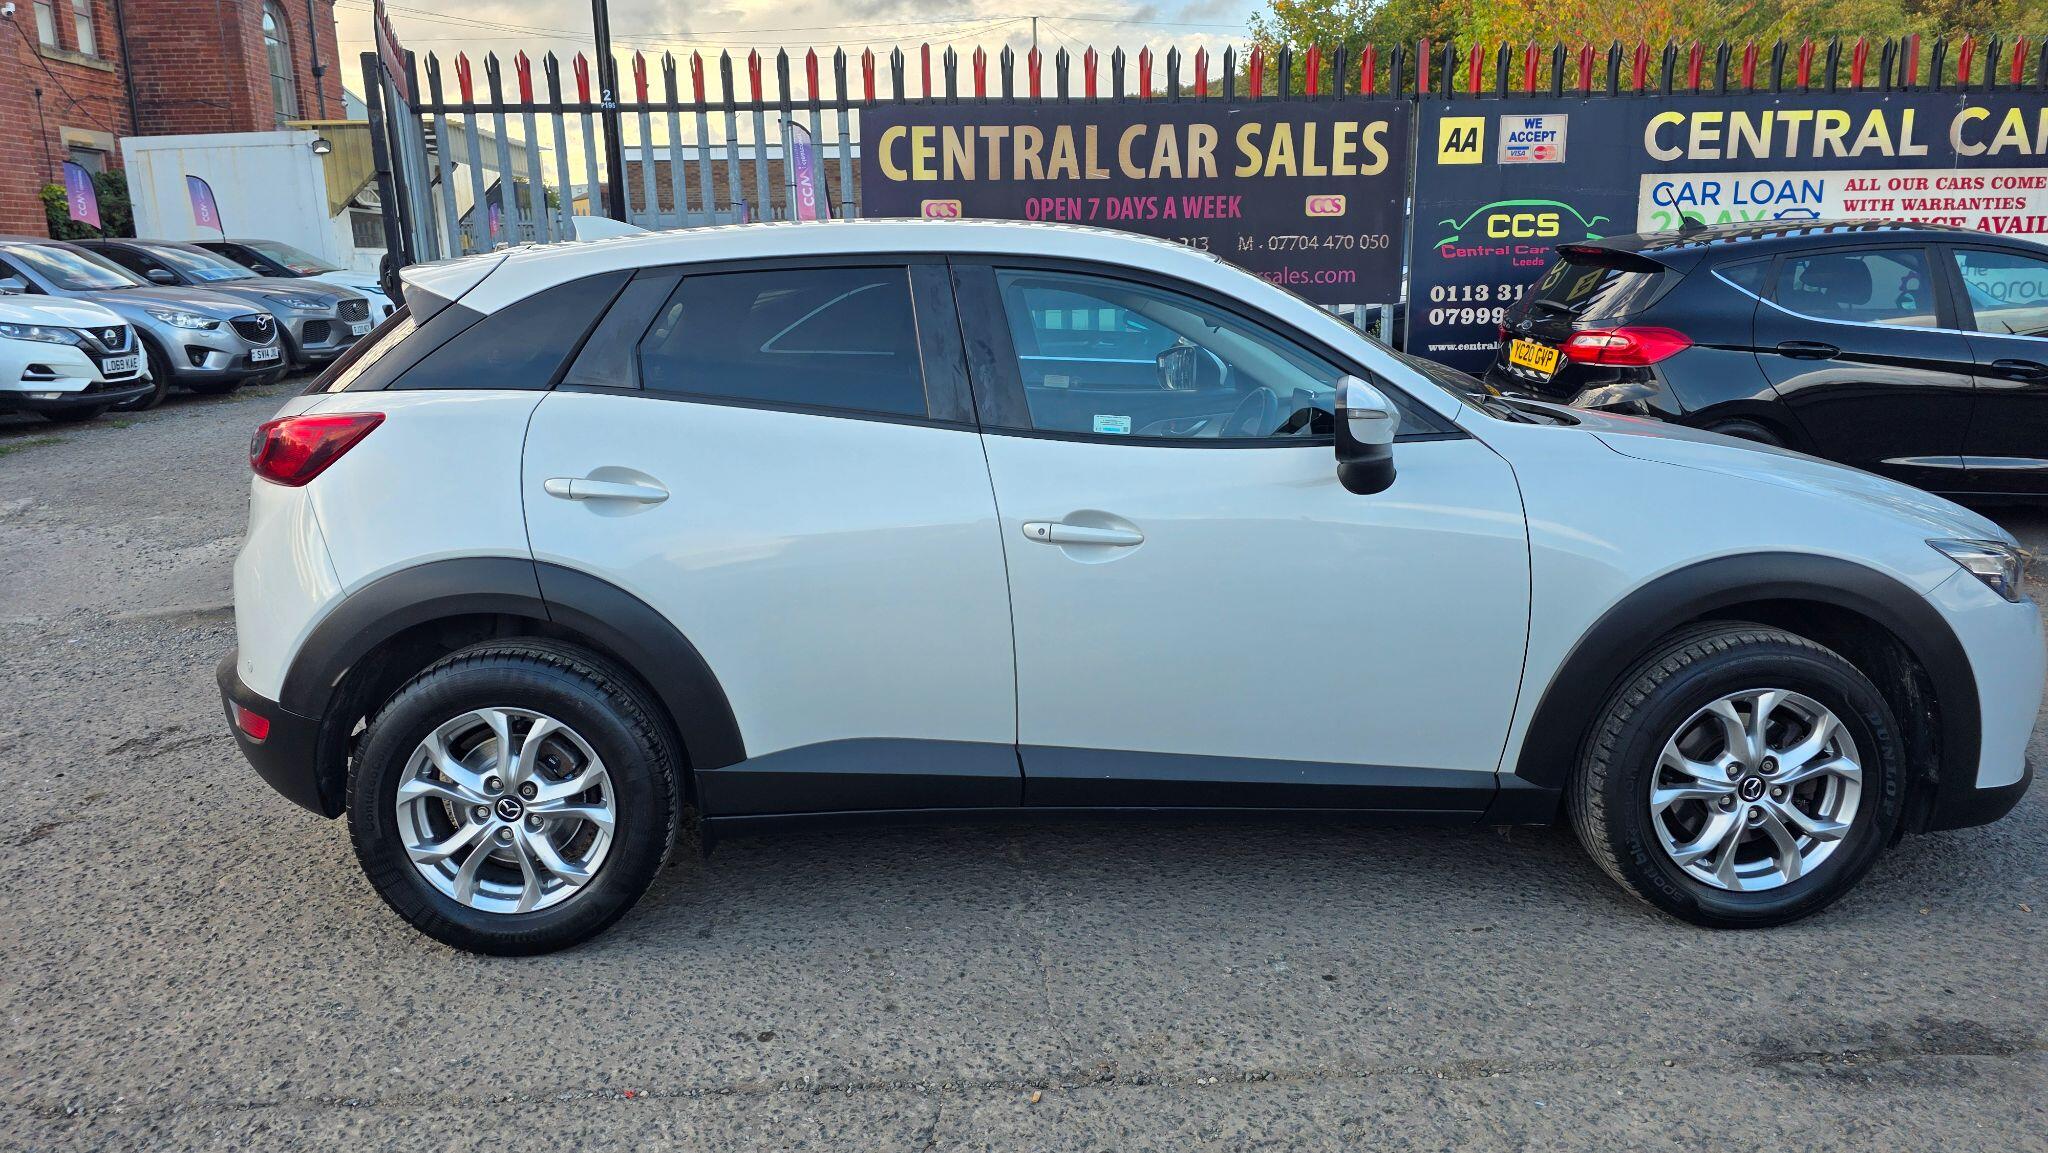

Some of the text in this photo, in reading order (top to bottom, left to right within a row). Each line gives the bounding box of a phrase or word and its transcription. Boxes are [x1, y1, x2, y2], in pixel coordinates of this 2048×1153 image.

[603, 89, 611, 101] 2
[1524, 118, 1543, 129] WE
[1443, 127, 1477, 153] AA
[1509, 131, 1556, 142] ACCEPT
[1644, 108, 1928, 161] CENTRAL
[878, 121, 1389, 181] CENTRAL CAR SALES
[1844, 176, 2047, 191] ALL OUR CARS COME
[1652, 179, 1824, 207] CAR LOAN
[1025, 195, 1242, 221] OPEN 7 DAYS A WEEK
[1843, 197, 2027, 212] WITH WARRANTIES
[1487, 213, 1560, 239] CCS
[1268, 235, 1318, 251] 07704
[1323, 235, 1354, 250] 470
[1360, 234, 1389, 250] 050
[1441, 244, 1550, 259] Central Car
[1513, 258, 1544, 266] Leeds
[1430, 284, 1534, 302] 0113 31
[1428, 307, 1504, 325] 07999
[1428, 341, 1501, 352] www.central
[1515, 342, 1554, 367] YC20 GVP
[1865, 710, 1897, 817] DUNLOP
